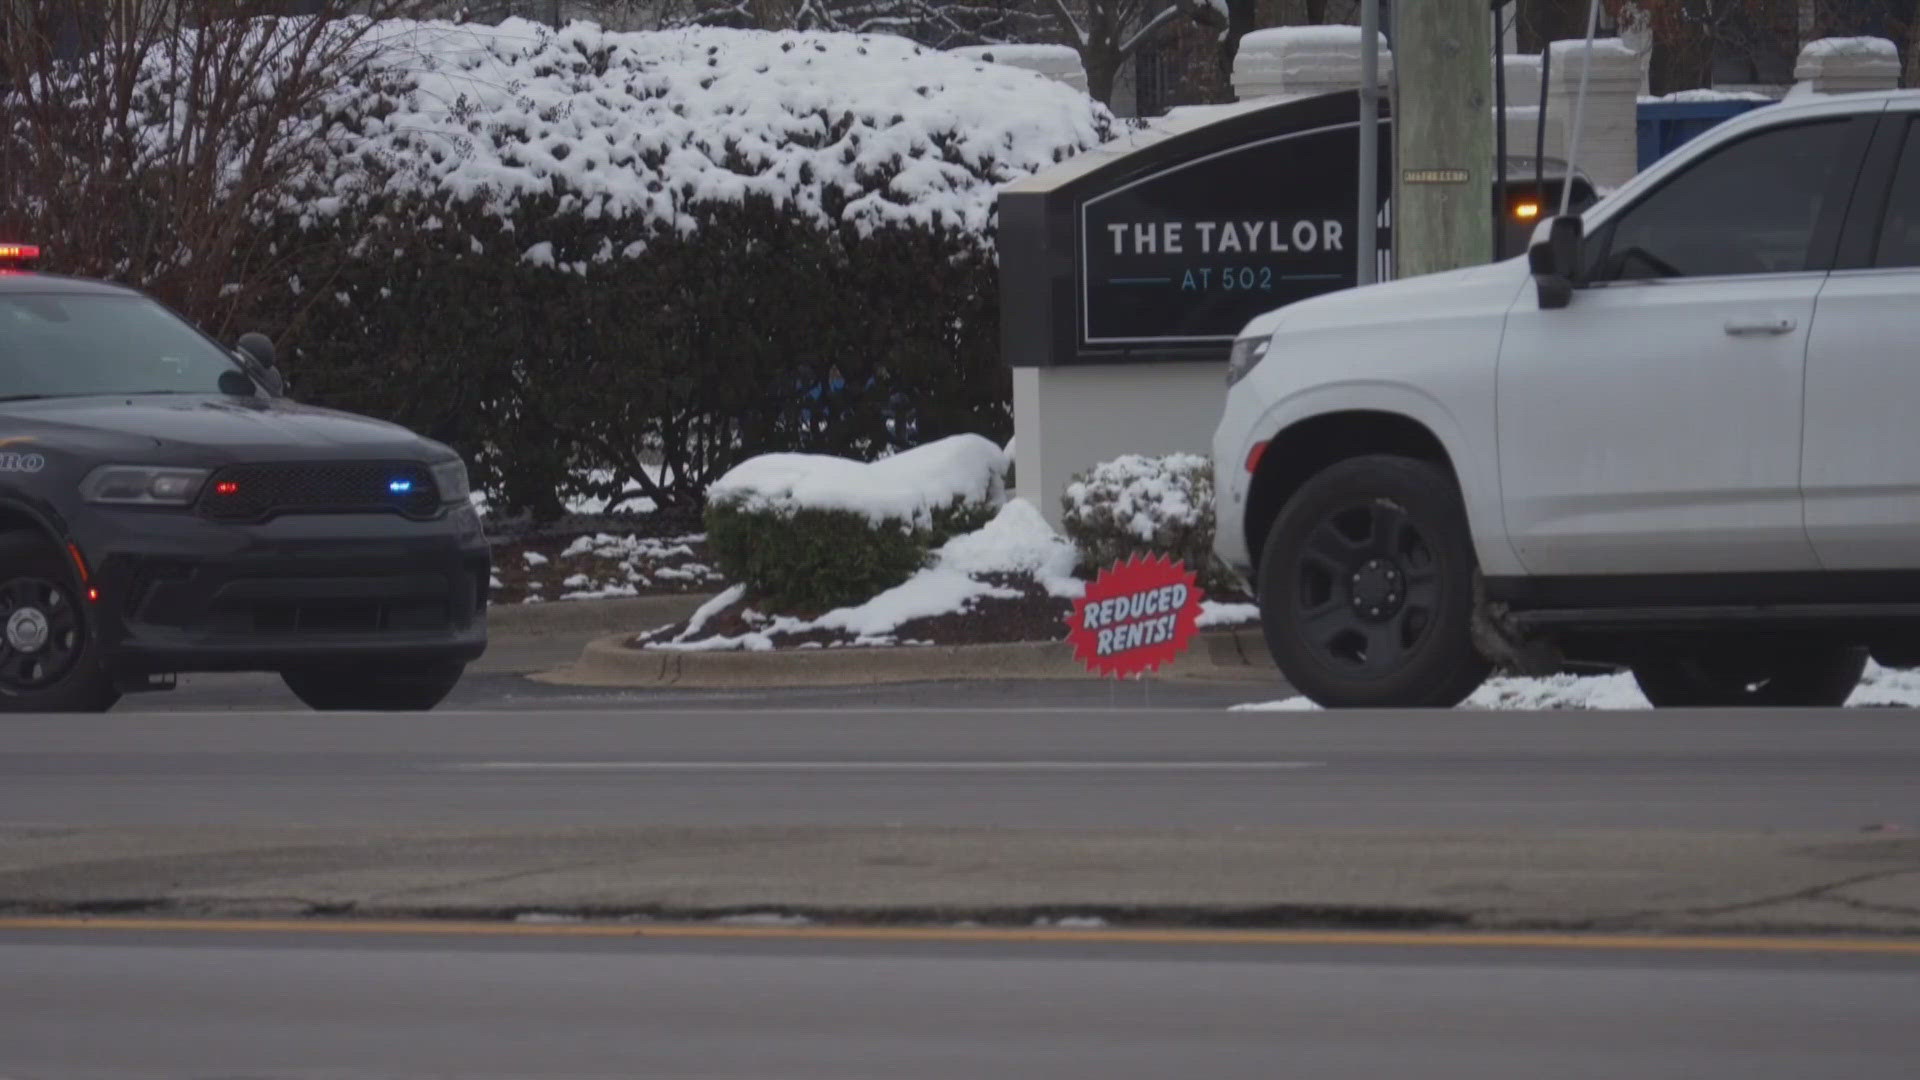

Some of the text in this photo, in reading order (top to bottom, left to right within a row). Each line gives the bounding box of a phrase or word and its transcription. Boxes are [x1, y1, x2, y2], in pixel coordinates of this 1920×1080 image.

[1107, 219, 1344, 255] THE TAYLOR
[1181, 266, 1272, 291] AT 502
[0, 452, 44, 473] RO
[1083, 583, 1188, 629] REDUCED
[1097, 613, 1177, 656] RENTS!
